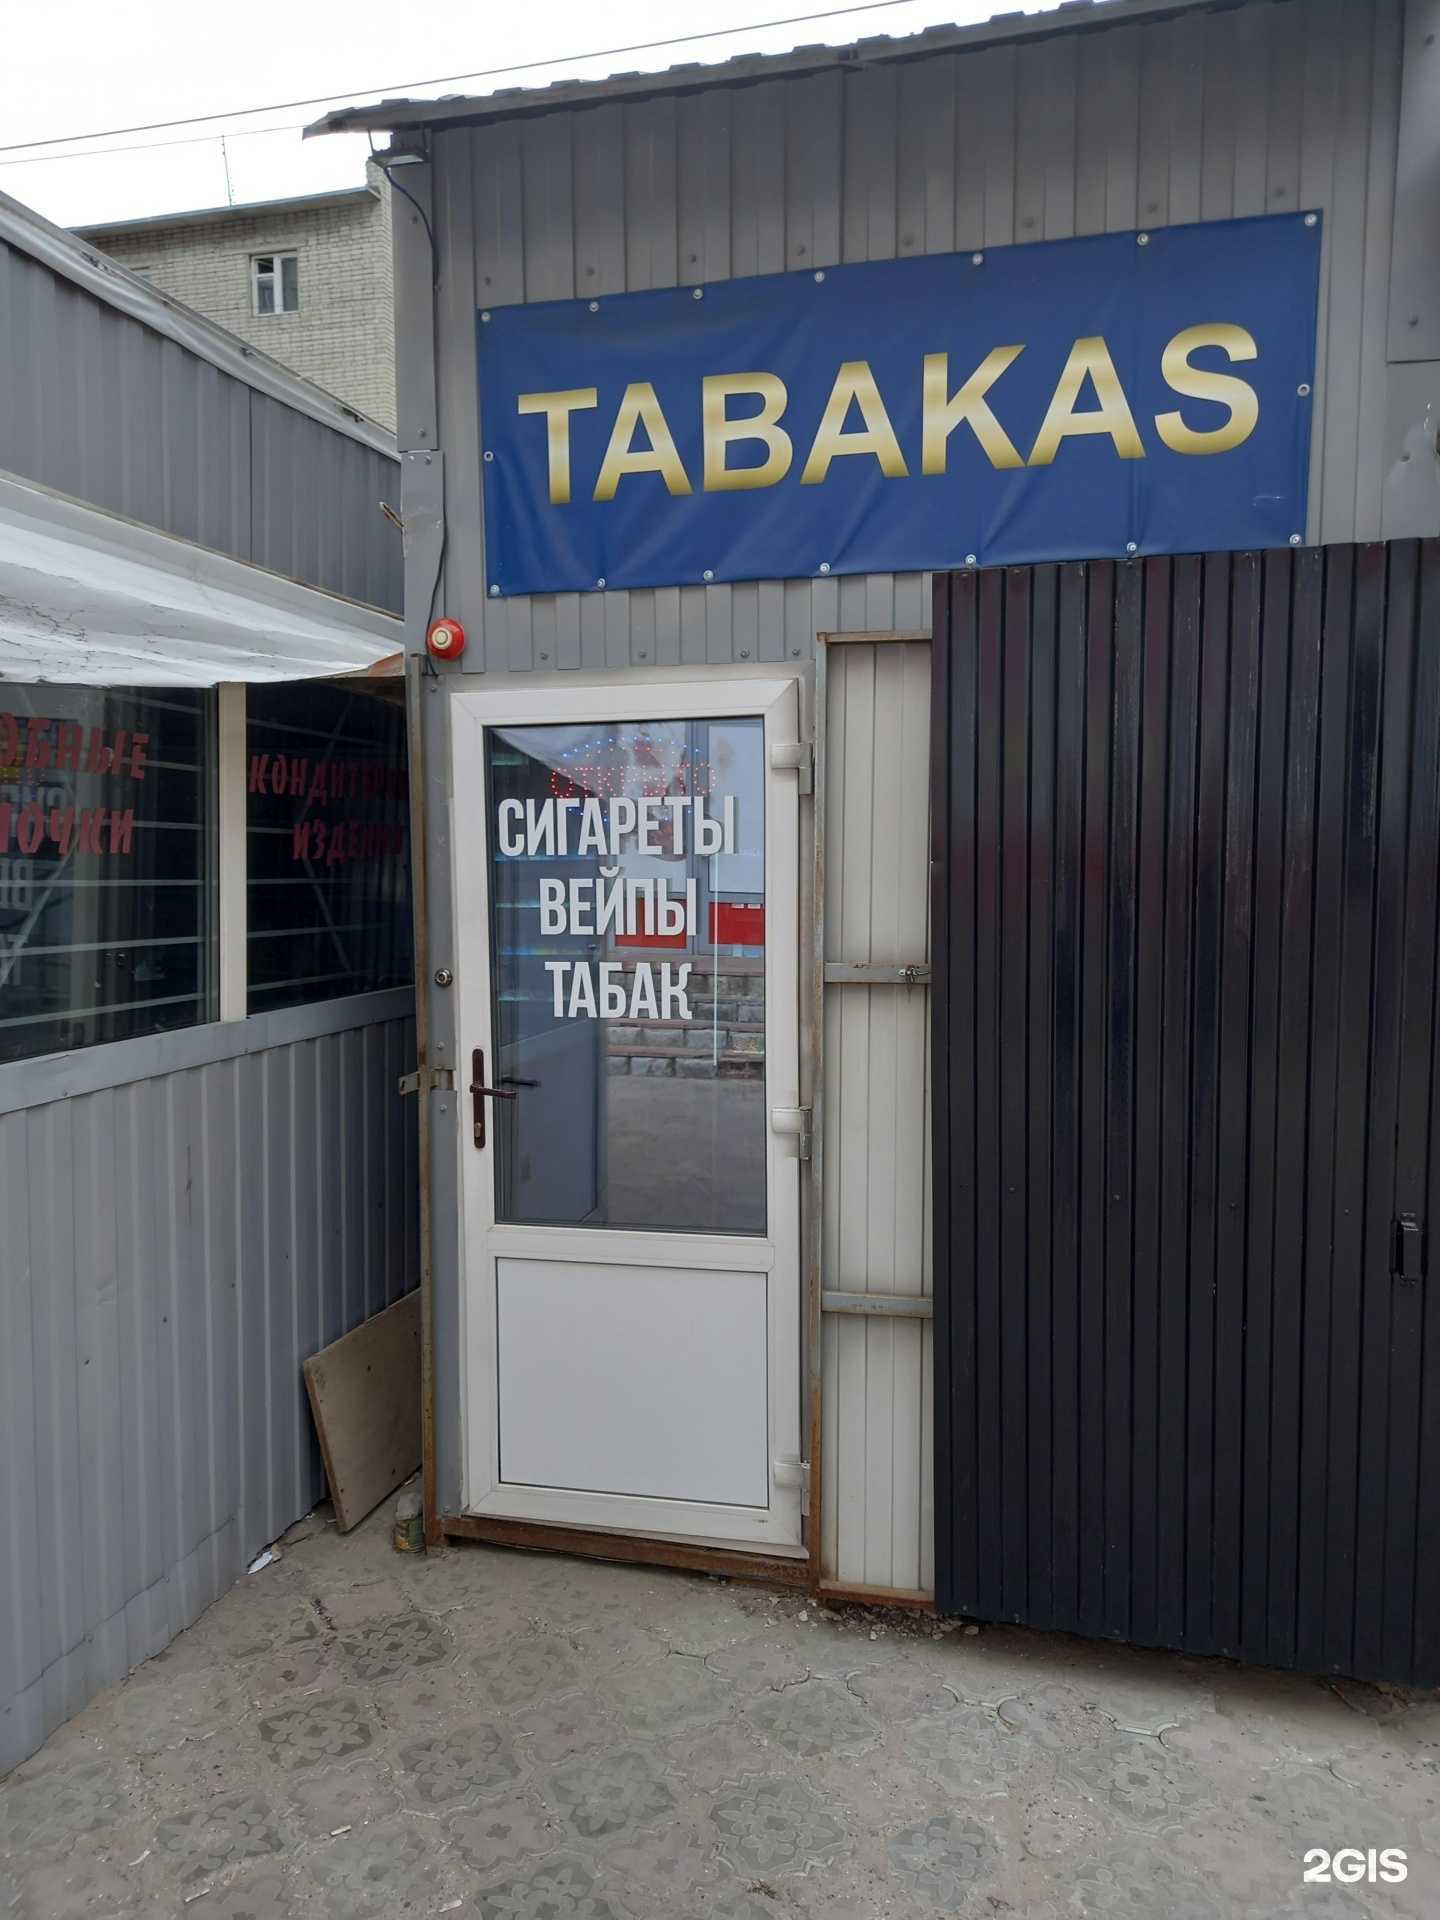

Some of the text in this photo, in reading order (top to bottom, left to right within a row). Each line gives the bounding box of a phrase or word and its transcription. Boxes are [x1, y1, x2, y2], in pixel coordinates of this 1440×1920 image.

[517, 322, 1260, 505] TABAKAS
[498, 795, 736, 857] СИГАРЕТЫ
[539, 866, 698, 937] ВЕЙПЫ
[544, 961, 694, 1020] ТАБАК
